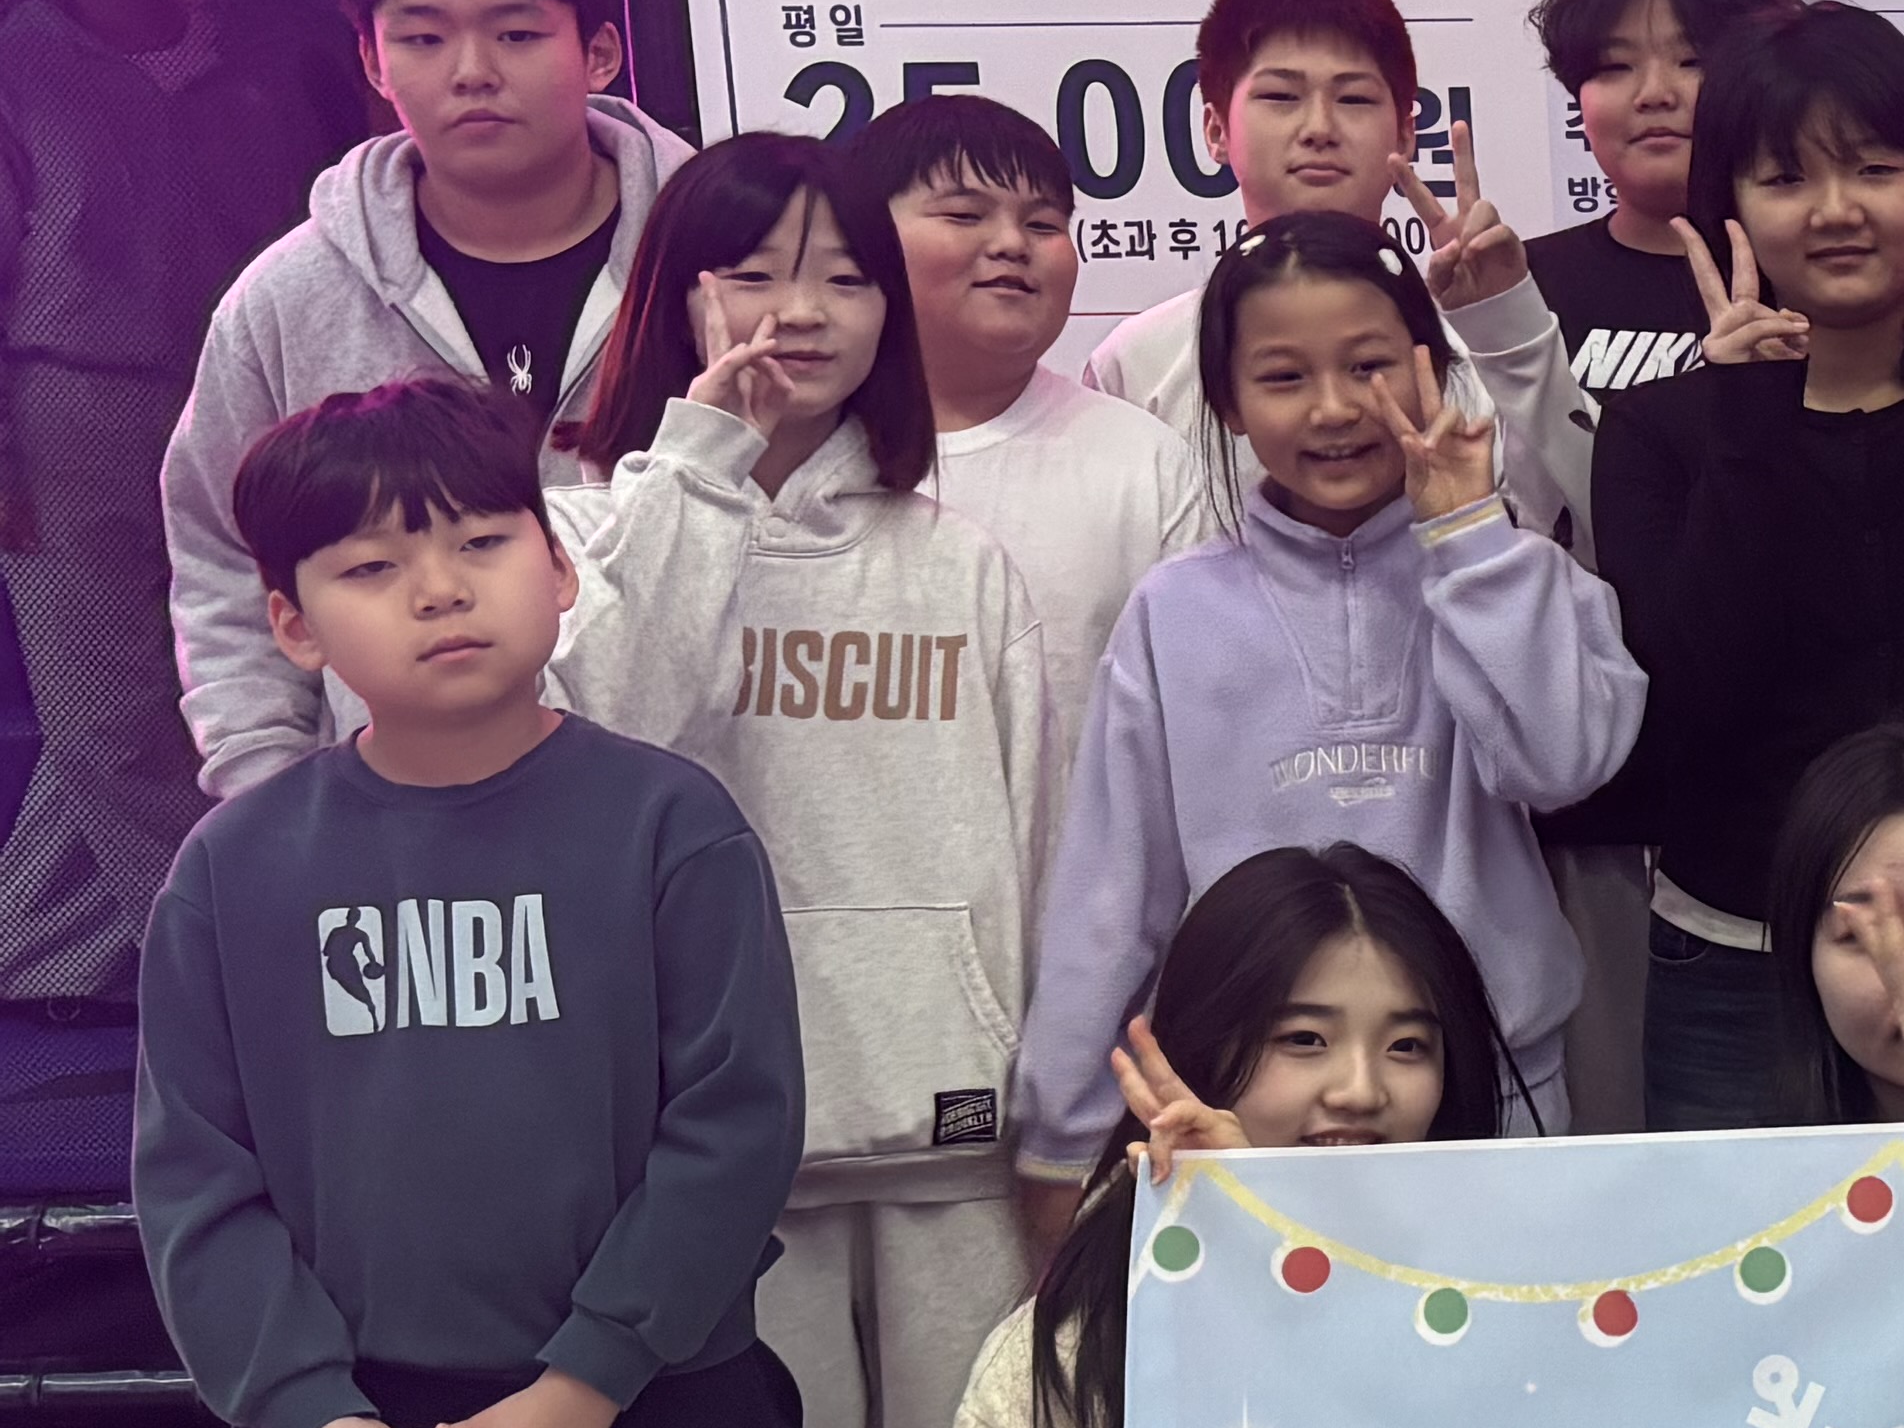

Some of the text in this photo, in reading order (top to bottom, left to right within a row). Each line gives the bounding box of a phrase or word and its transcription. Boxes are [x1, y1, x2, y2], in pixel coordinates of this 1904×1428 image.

[1077, 218, 1157, 262] (초과
[1169, 218, 1200, 260] 후
[397, 894, 559, 1028] NBA
